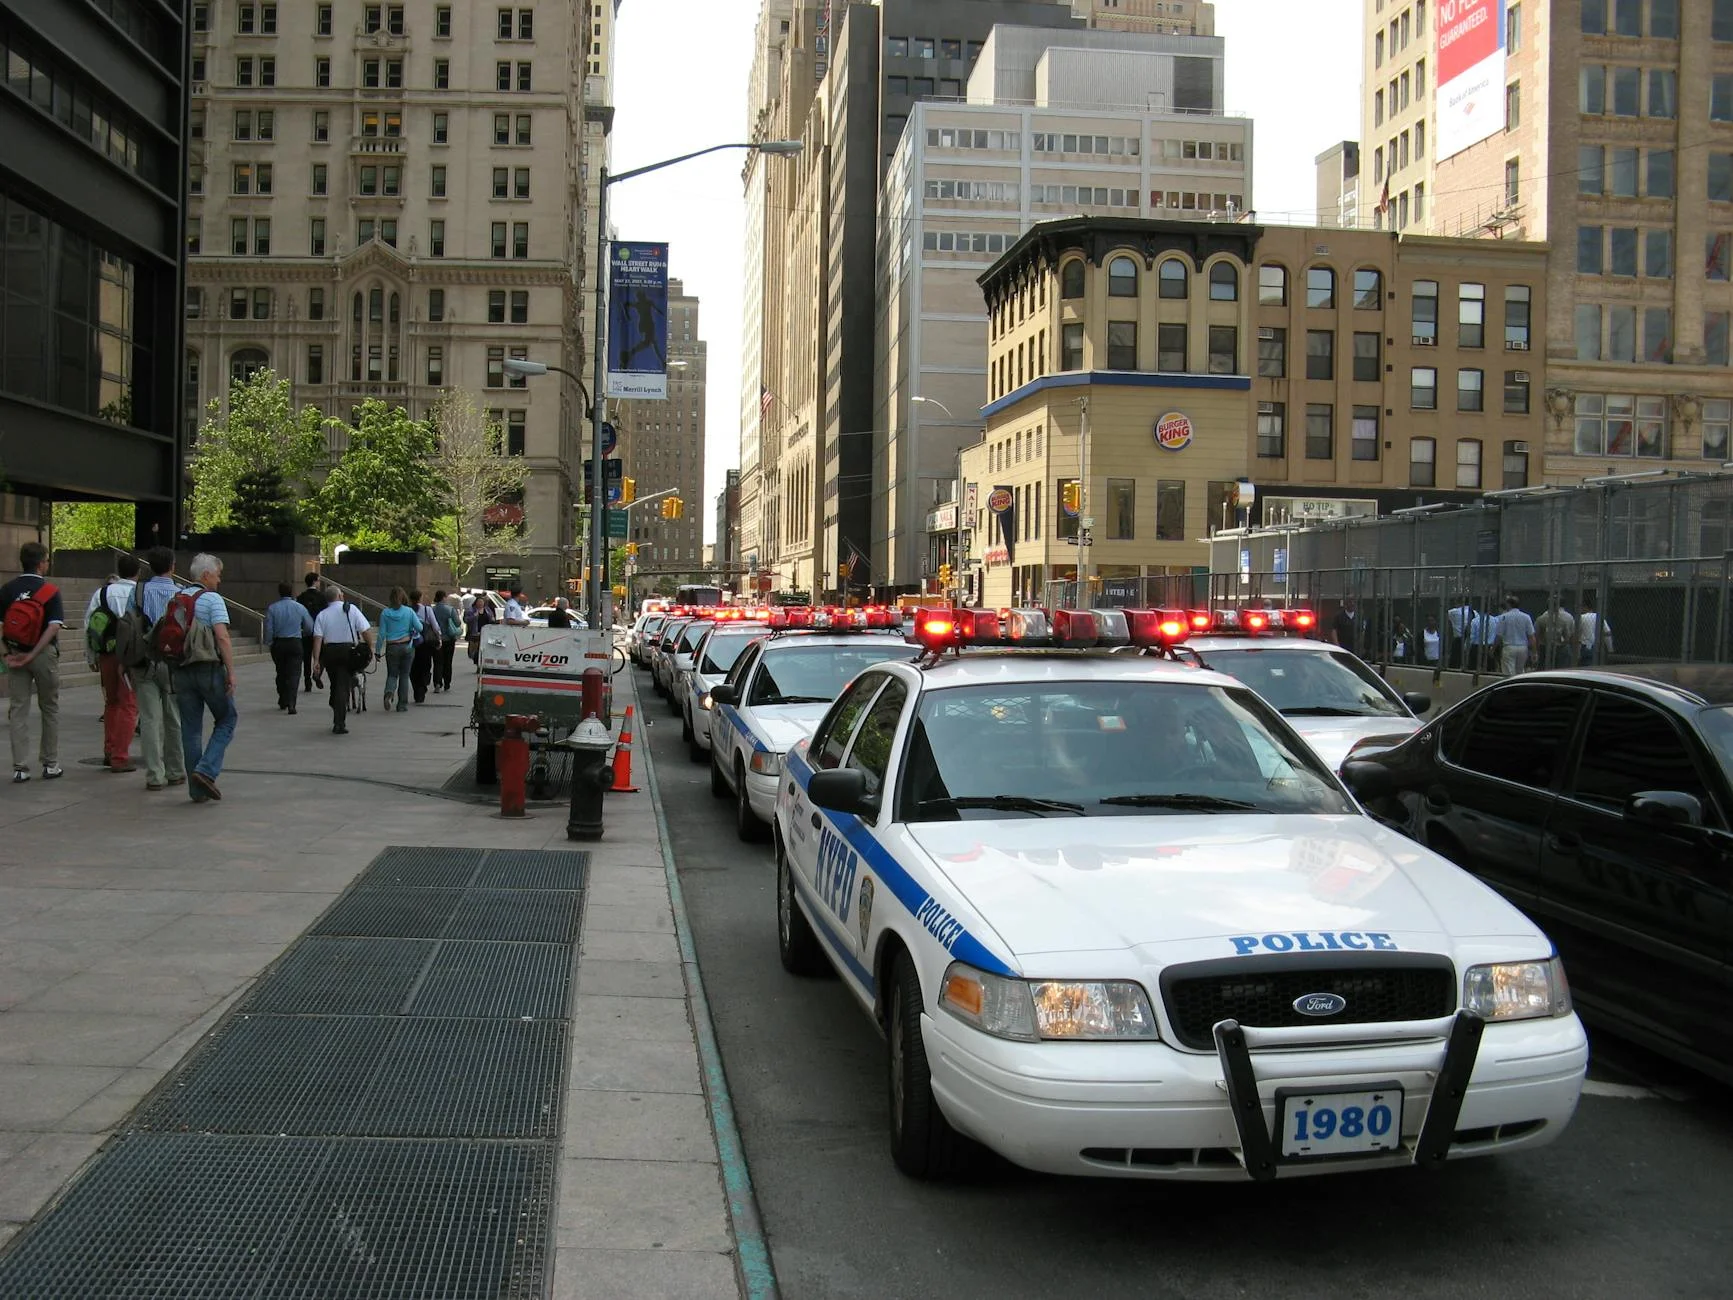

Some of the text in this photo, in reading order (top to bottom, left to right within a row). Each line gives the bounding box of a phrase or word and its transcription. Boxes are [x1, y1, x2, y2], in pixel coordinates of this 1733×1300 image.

[1440, 0, 1455, 28] NO
[1440, 6, 1488, 49] GUARANTEED.
[1159, 419, 1188, 433] BURGER
[1160, 426, 1190, 443] KING
[991, 498, 1010, 507] KING
[514, 651, 569, 667] verizon
[816, 826, 858, 923] NYPD
[916, 897, 964, 947] POLICE
[1228, 932, 1398, 955] POLICE
[1306, 997, 1334, 1011] Ford
[1294, 1105, 1392, 1141] 1980
